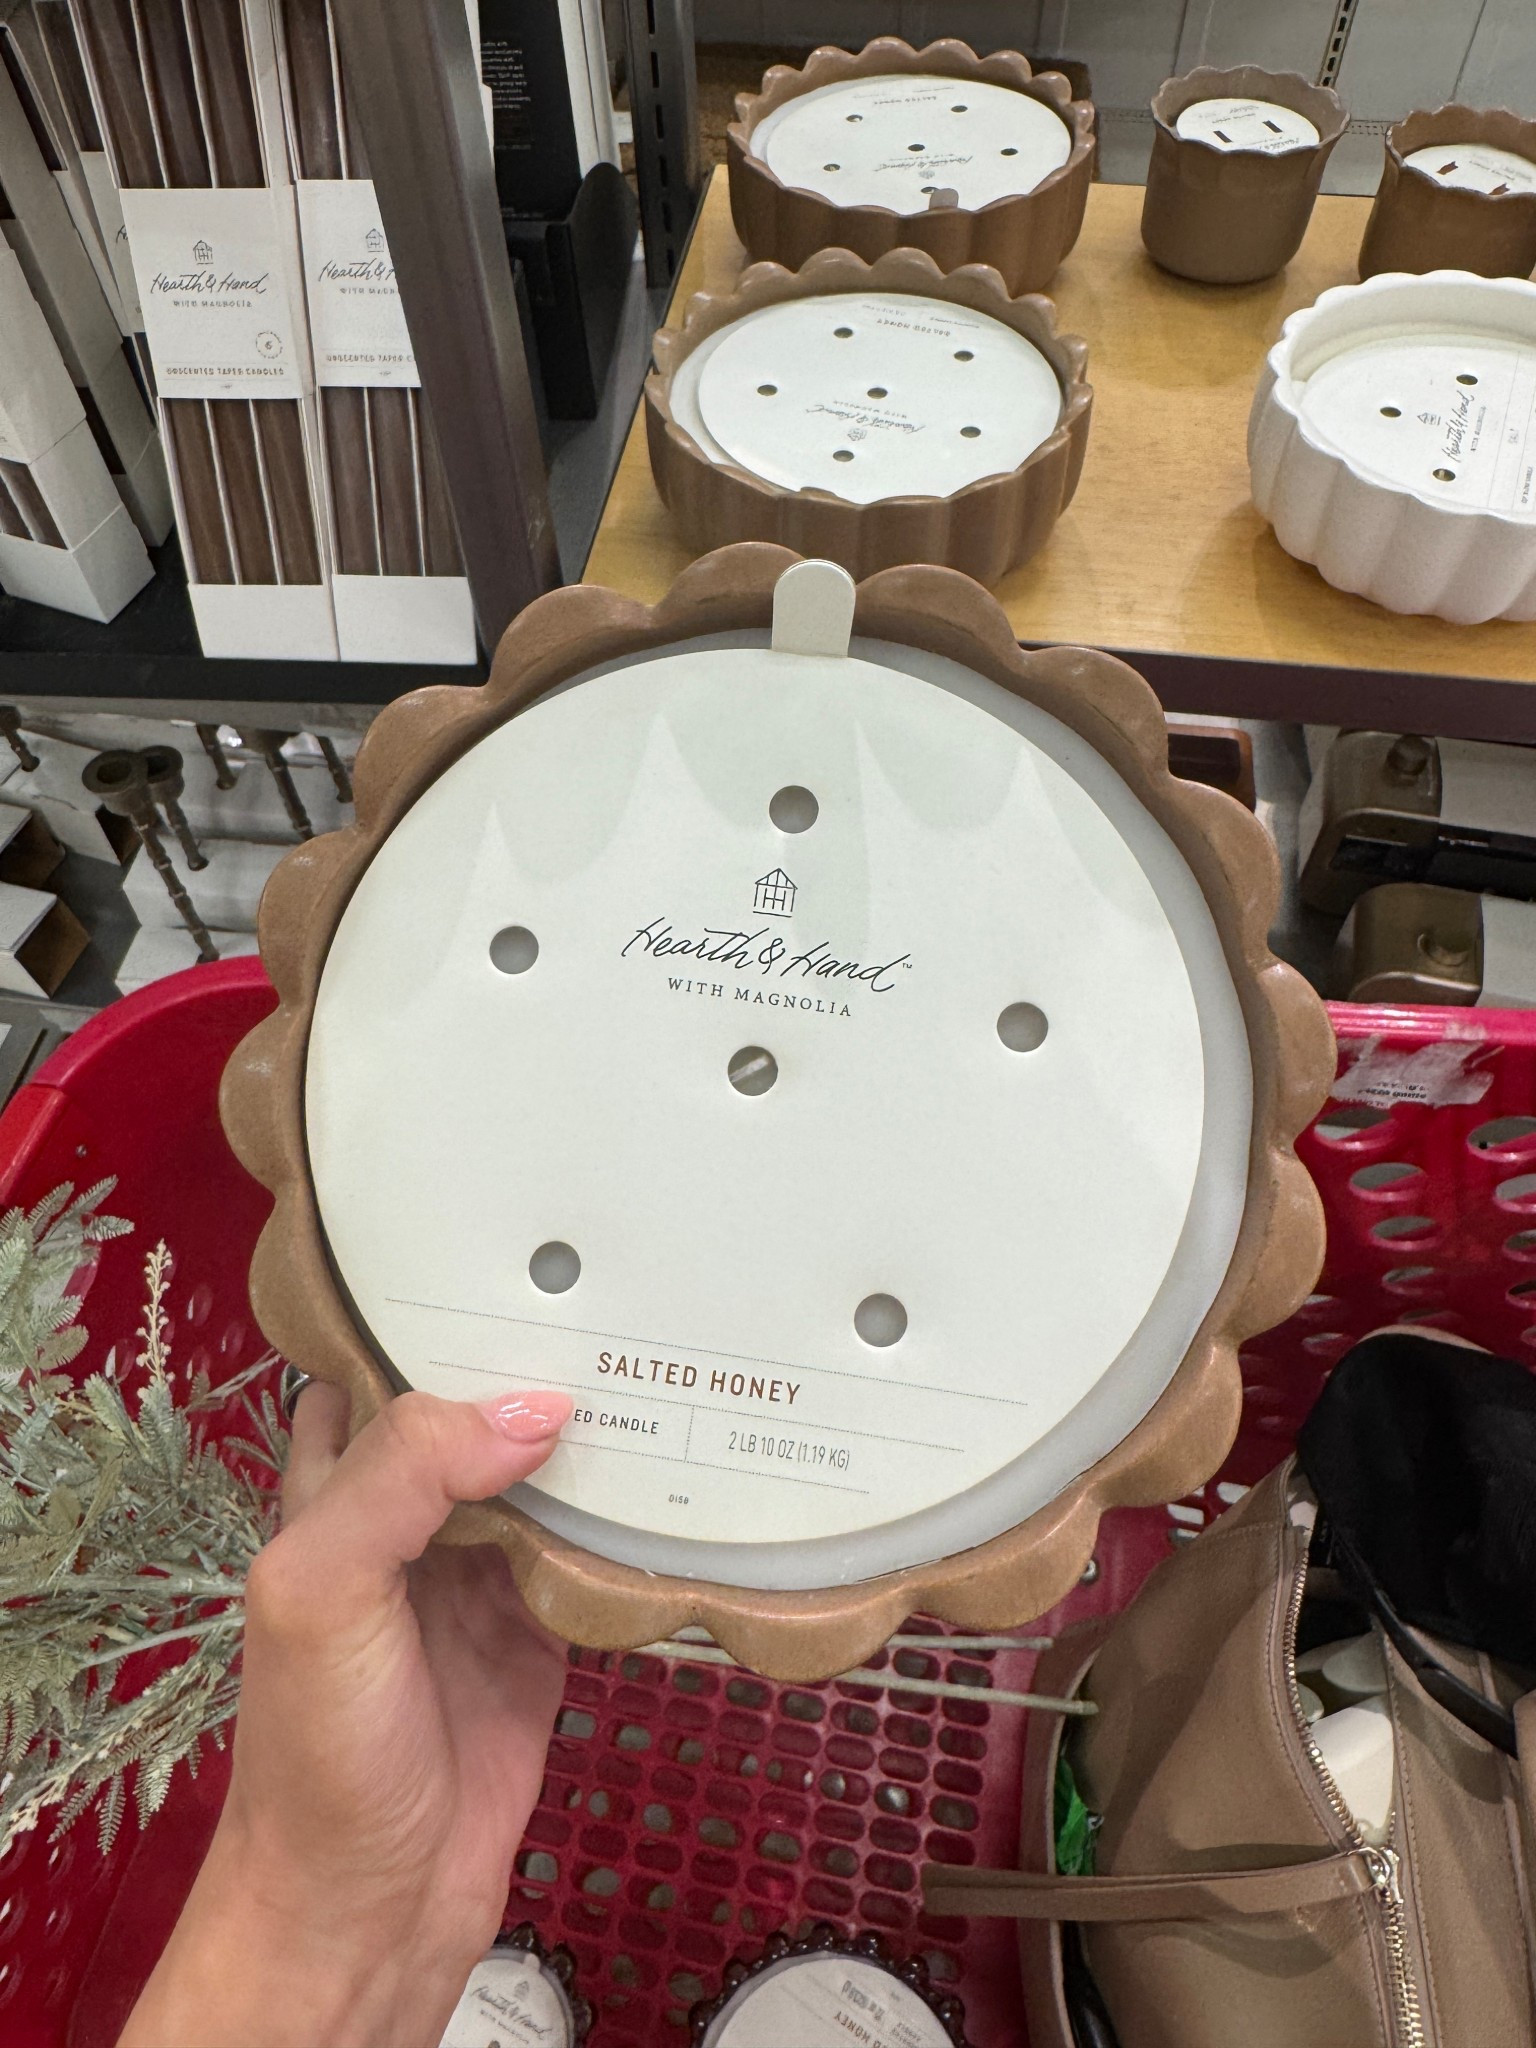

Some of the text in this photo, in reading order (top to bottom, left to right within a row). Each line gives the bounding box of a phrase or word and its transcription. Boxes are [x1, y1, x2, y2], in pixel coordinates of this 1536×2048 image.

[150, 271, 269, 294] Hearth & Hand
[621, 917, 769, 969] Hearth
[758, 937, 785, 974] &
[780, 941, 911, 993] Hand
[668, 977, 852, 1018] WITH MAGNOLIA
[597, 1351, 801, 1405] SALTED HONEY
[574, 1408, 659, 1435] ED CANDLE
[728, 1430, 851, 1471] 2 LB 10 OZ (1.19 KG)
